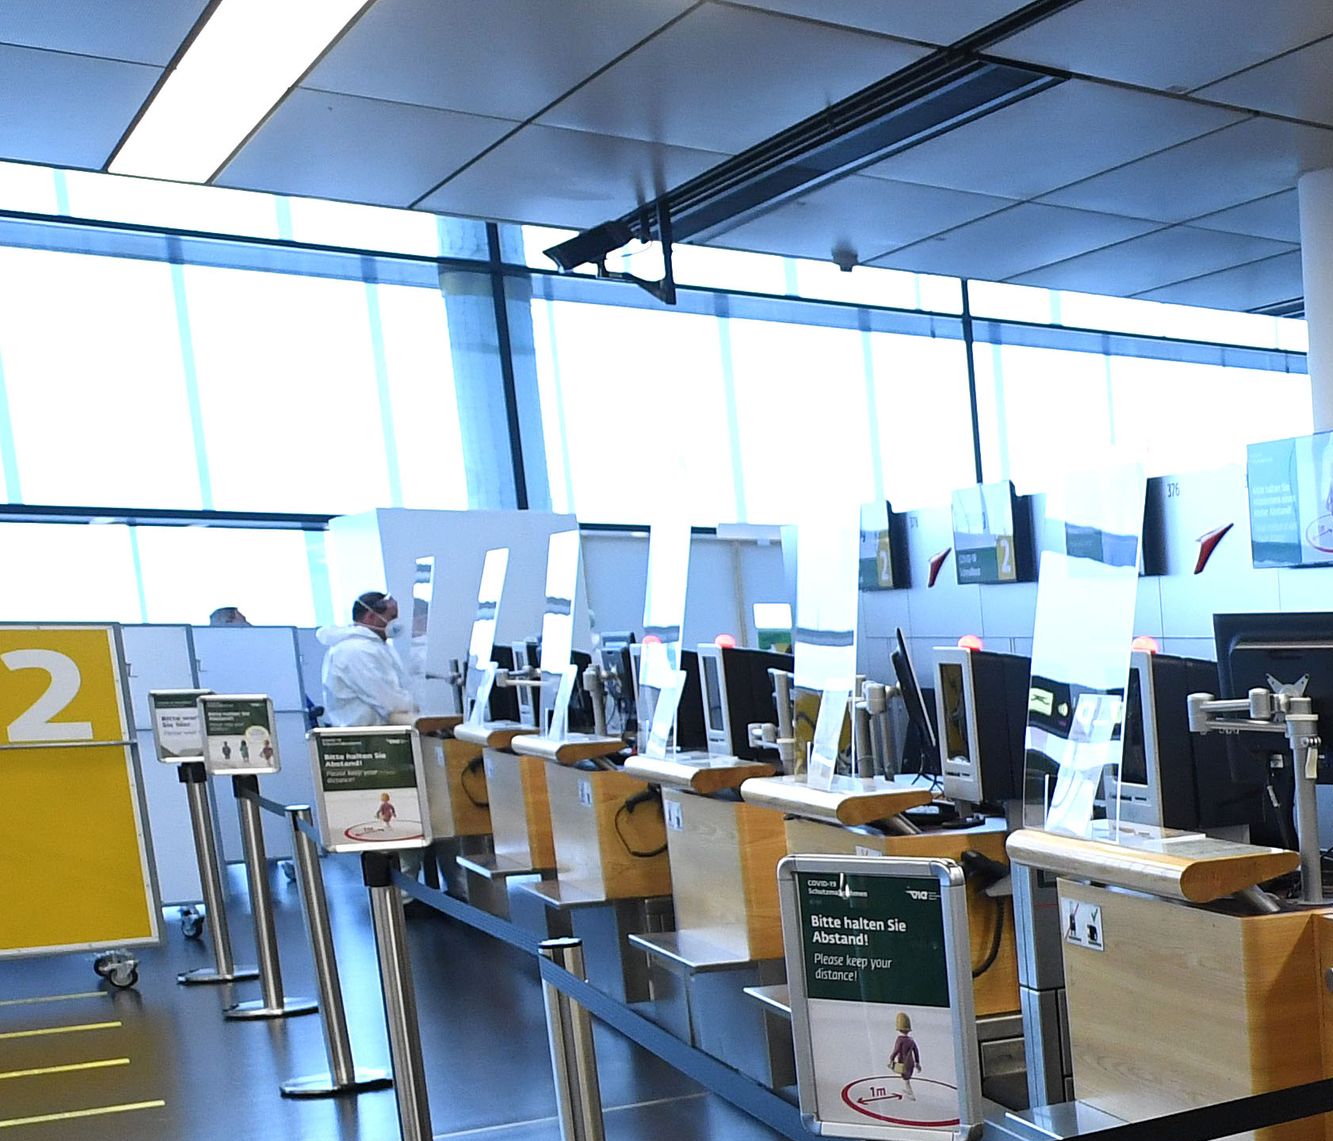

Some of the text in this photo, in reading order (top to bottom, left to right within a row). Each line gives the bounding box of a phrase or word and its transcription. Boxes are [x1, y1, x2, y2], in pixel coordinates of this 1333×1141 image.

[1000, 539, 1011, 573] 2
[0, 648, 93, 742] 2
[807, 880, 836, 888] COVID-19
[811, 914, 907, 932] Bitte halten Sie
[812, 931, 869, 946] Abstand!
[814, 953, 892, 970] Please keep your
[815, 968, 858, 981] distance!
[870, 1086, 886, 1097] 1m
